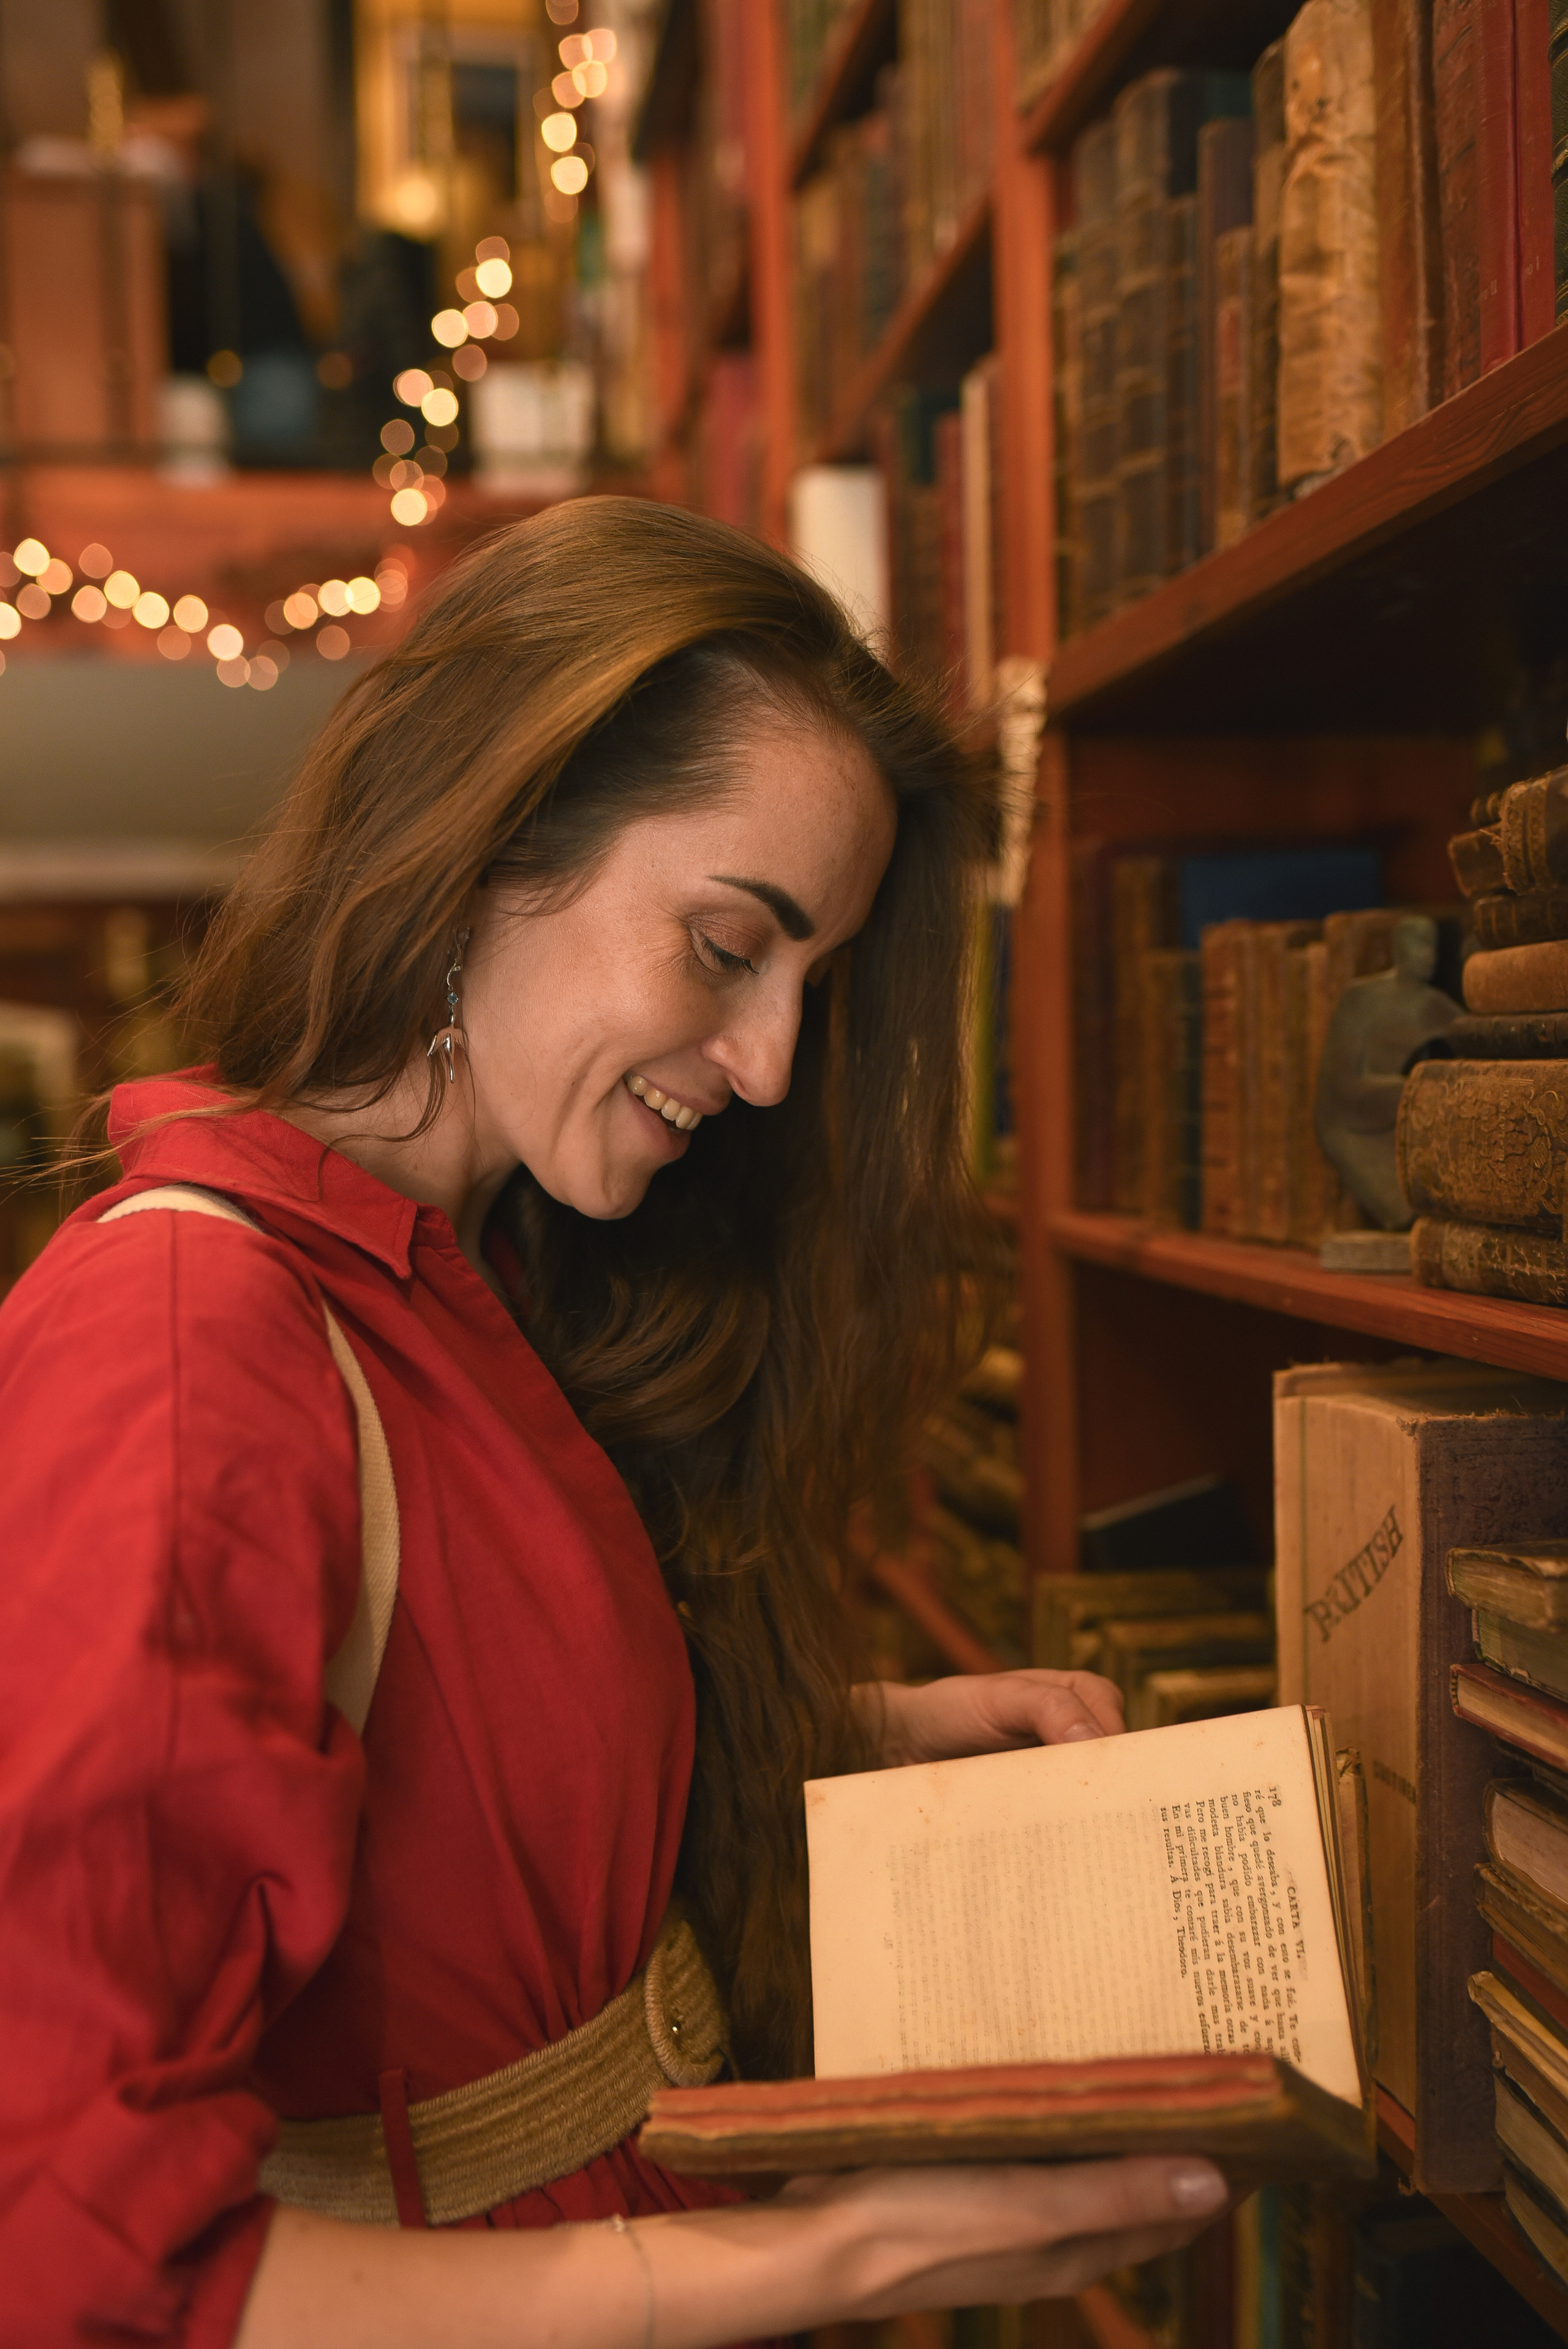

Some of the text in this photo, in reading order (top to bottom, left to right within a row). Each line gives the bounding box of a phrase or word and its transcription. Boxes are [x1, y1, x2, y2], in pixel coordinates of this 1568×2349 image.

[1243, 1791, 1253, 1814] fieso
[1254, 1790, 1265, 1800] ré
[1268, 1787, 1281, 1807] 178
[1196, 1800, 1205, 1823] Pero
[1256, 1806, 1265, 1824] que
[1199, 1828, 1207, 1842] me
[1246, 1817, 1256, 1836] que
[1263, 1832, 1272, 1842] lo
[1187, 1826, 1201, 1882] dificultades
[1202, 1846, 1215, 1877] recogí
[1250, 1840, 1265, 1869] quedé
[1164, 1827, 1175, 1867] resultas.
[1170, 1875, 1183, 1885] Á
[1177, 1926, 1187, 1978] Theodoro.
[1194, 1890, 1204, 1908] que
[1205, 1882, 1216, 1905] para
[1220, 1795, 1229, 1820] buen
[1229, 1879, 1240, 1897] que
[1239, 1931, 1246, 1943] su
[1246, 1978, 1256, 2007] suave
[1231, 1794, 1238, 1806] no
[1238, 1853, 1253, 1886] podido
[1247, 1895, 1261, 1947] embarazar
[1261, 1985, 1270, 2011] nada
[1208, 1798, 1219, 1837] modesta
[1215, 1845, 1226, 1890] blandura
[1227, 1932, 1243, 2011] desembarazarse
[1240, 2021, 1248, 2033] de
[1257, 1875, 1274, 1939] avergonzado
[1172, 1804, 1210, 2055] En mi primera te contaré mis nuevos esfuerzo
[1287, 1886, 1305, 1959] CARTA VI.
[1197, 1916, 1210, 1960] pudieran
[1216, 1953, 1225, 1963] la
[1268, 1945, 1276, 1958] de
[1280, 1943, 1289, 1963] esto
[1206, 1969, 1217, 1996] darle
[1284, 1969, 1291, 1980] se
[1219, 1970, 1232, 2013] memoria
[1272, 1989, 1281, 2007] que
[1211, 2005, 1219, 2025] mas
[1276, 2012, 1285, 2040] hasta
[1289, 2014, 1298, 2030] Te
[1226, 2018, 1235, 2044] otras
[1215, 2033, 1226, 2055] trab
[1280, 2046, 1292, 2066] all
